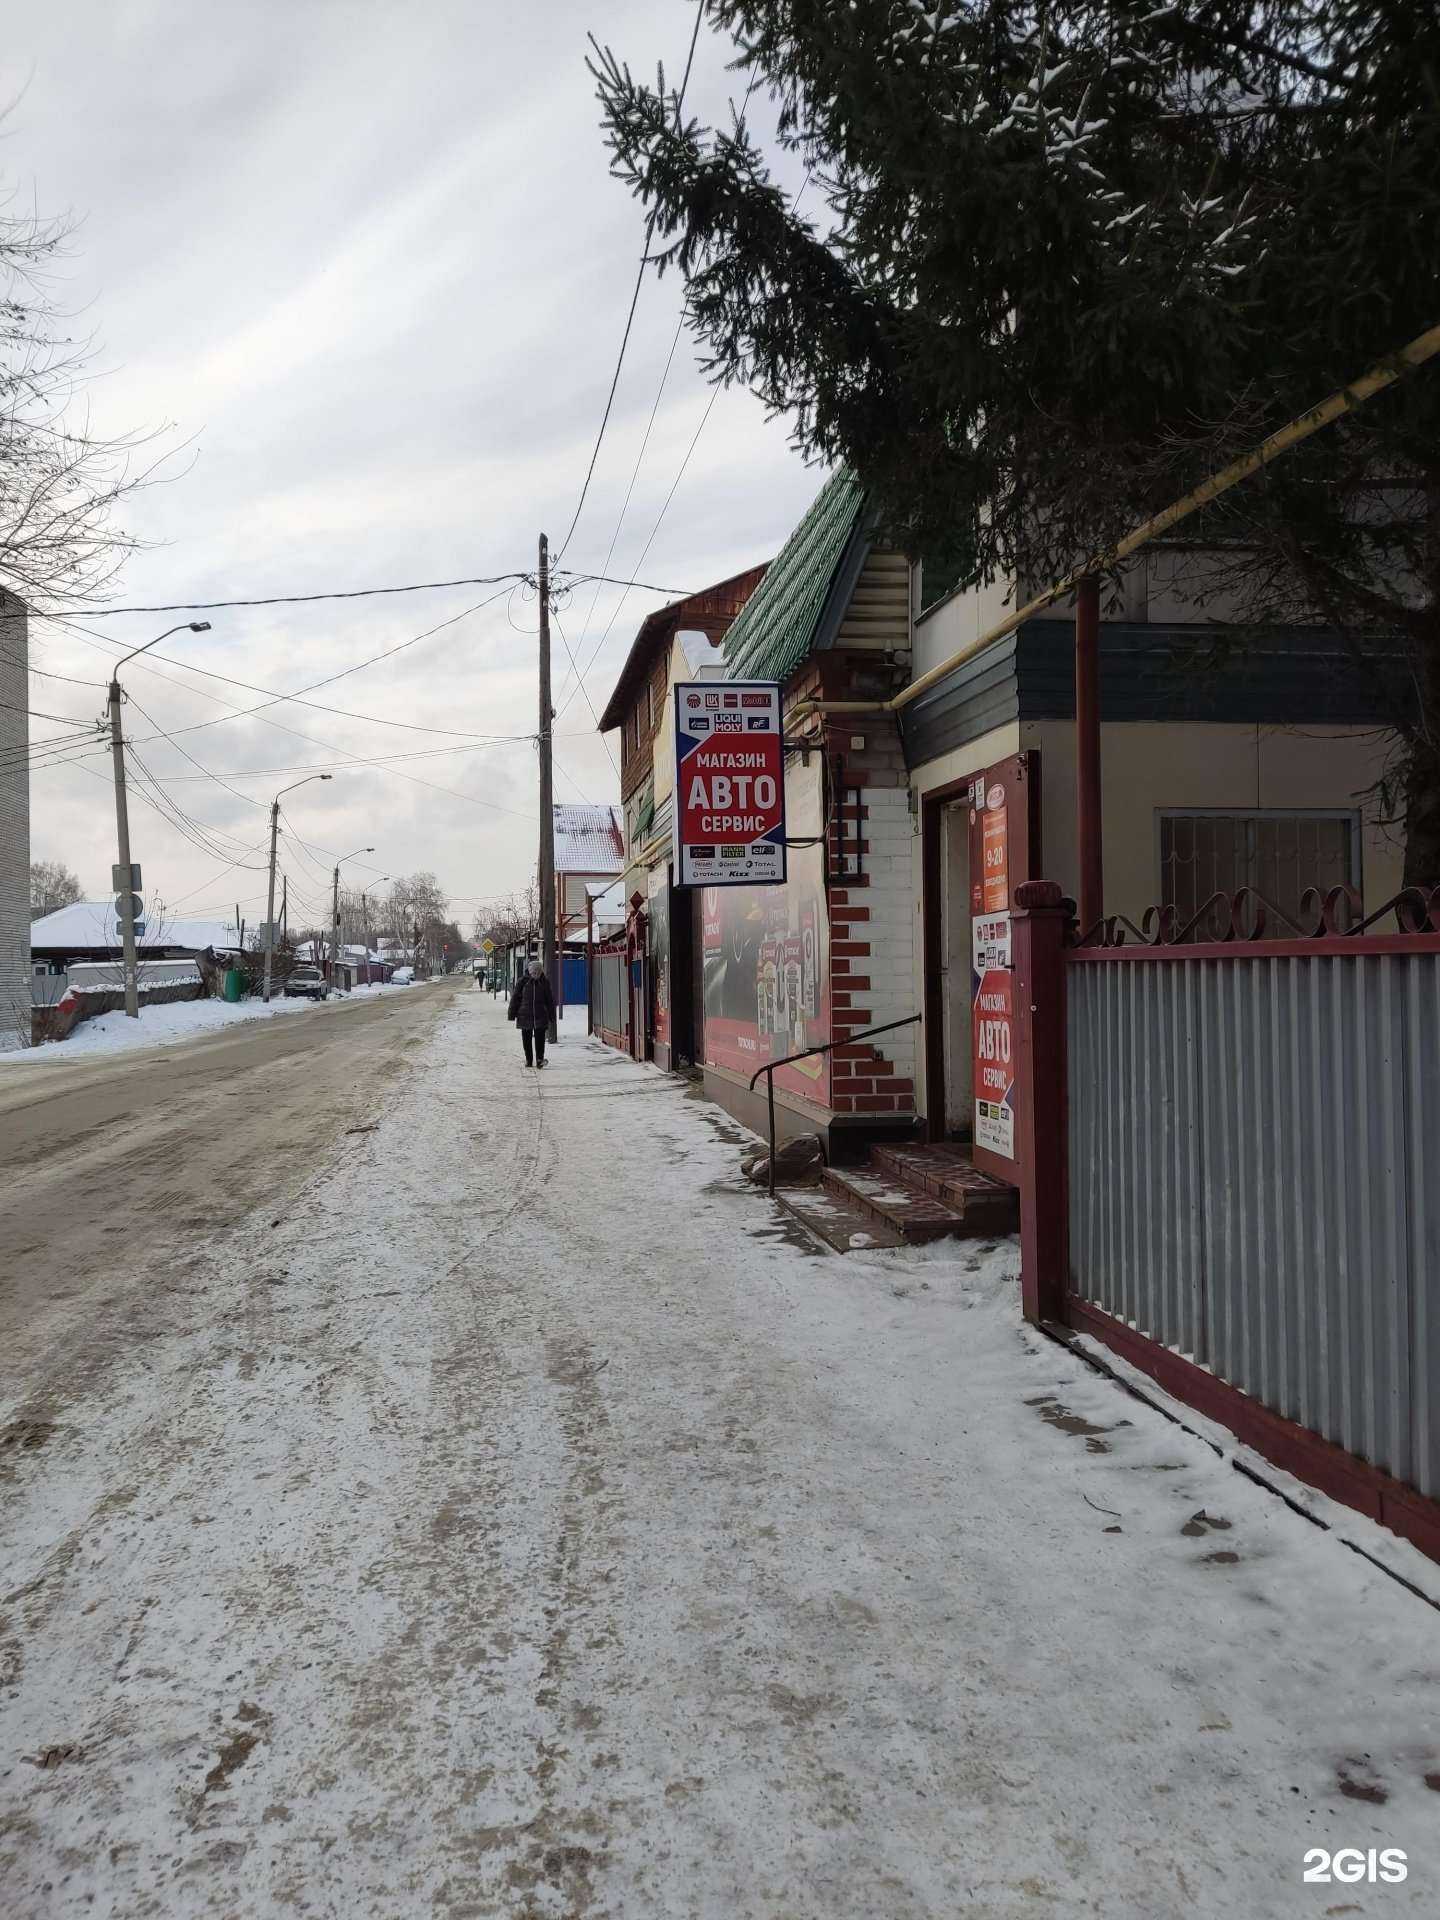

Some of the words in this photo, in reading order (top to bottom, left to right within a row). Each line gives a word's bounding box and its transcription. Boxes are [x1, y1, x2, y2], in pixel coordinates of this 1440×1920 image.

[715, 714, 742, 723] LIQUI
[715, 724, 743, 732] MOLY
[696, 752, 767, 768] МАГАЗИН
[687, 774, 777, 810] АВТО
[701, 815, 766, 832] СЕРВИС
[752, 846, 766, 854] elf
[979, 1020, 1011, 1063] АВТО
[983, 1067, 1007, 1090] СЕРВИС
